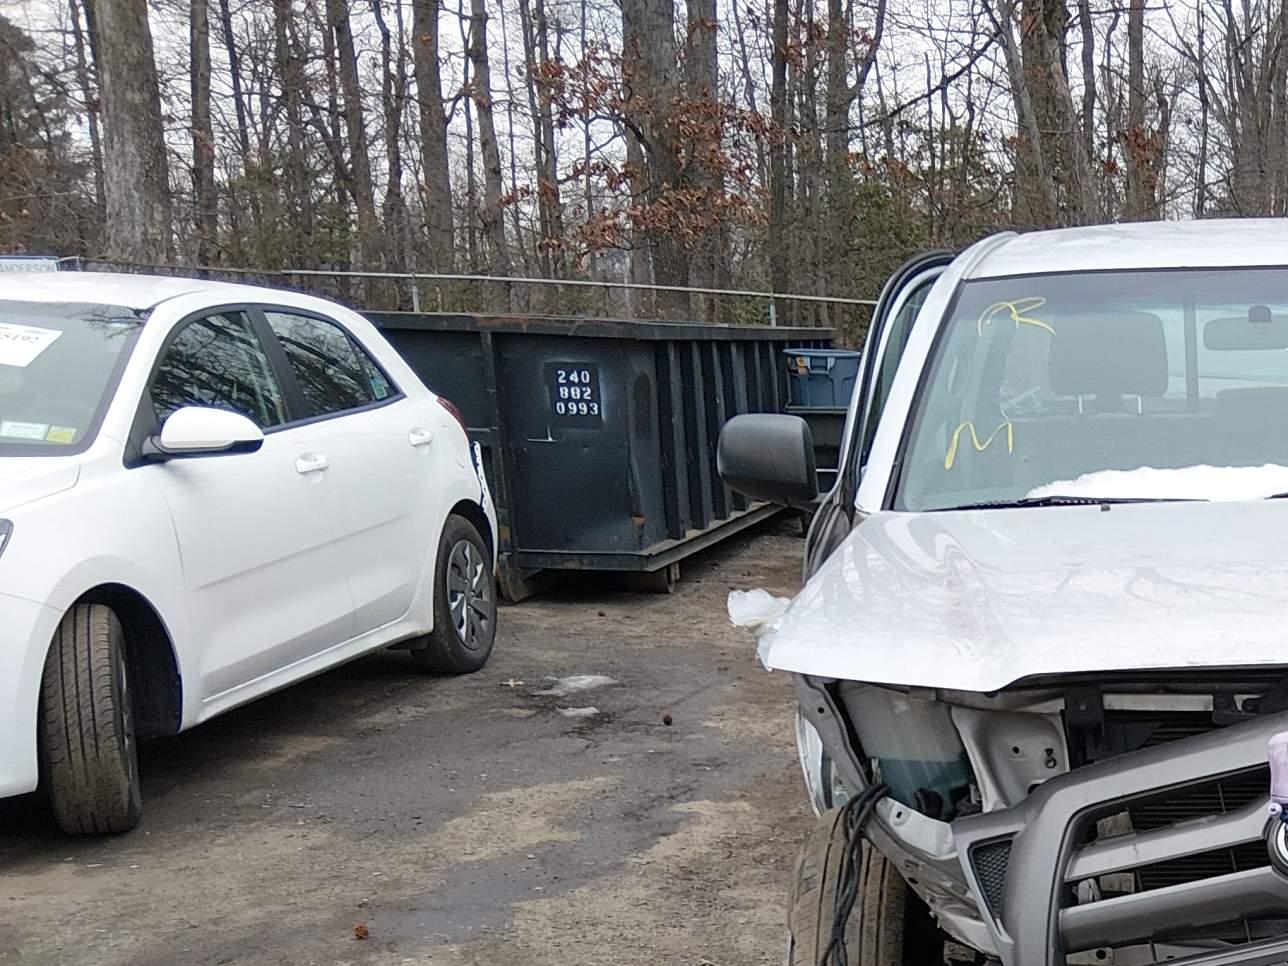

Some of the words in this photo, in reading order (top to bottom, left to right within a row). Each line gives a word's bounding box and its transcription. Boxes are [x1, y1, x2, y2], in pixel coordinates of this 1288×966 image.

[557, 369, 590, 384] 240
[559, 386, 592, 400] 882
[555, 401, 599, 415] 0993
